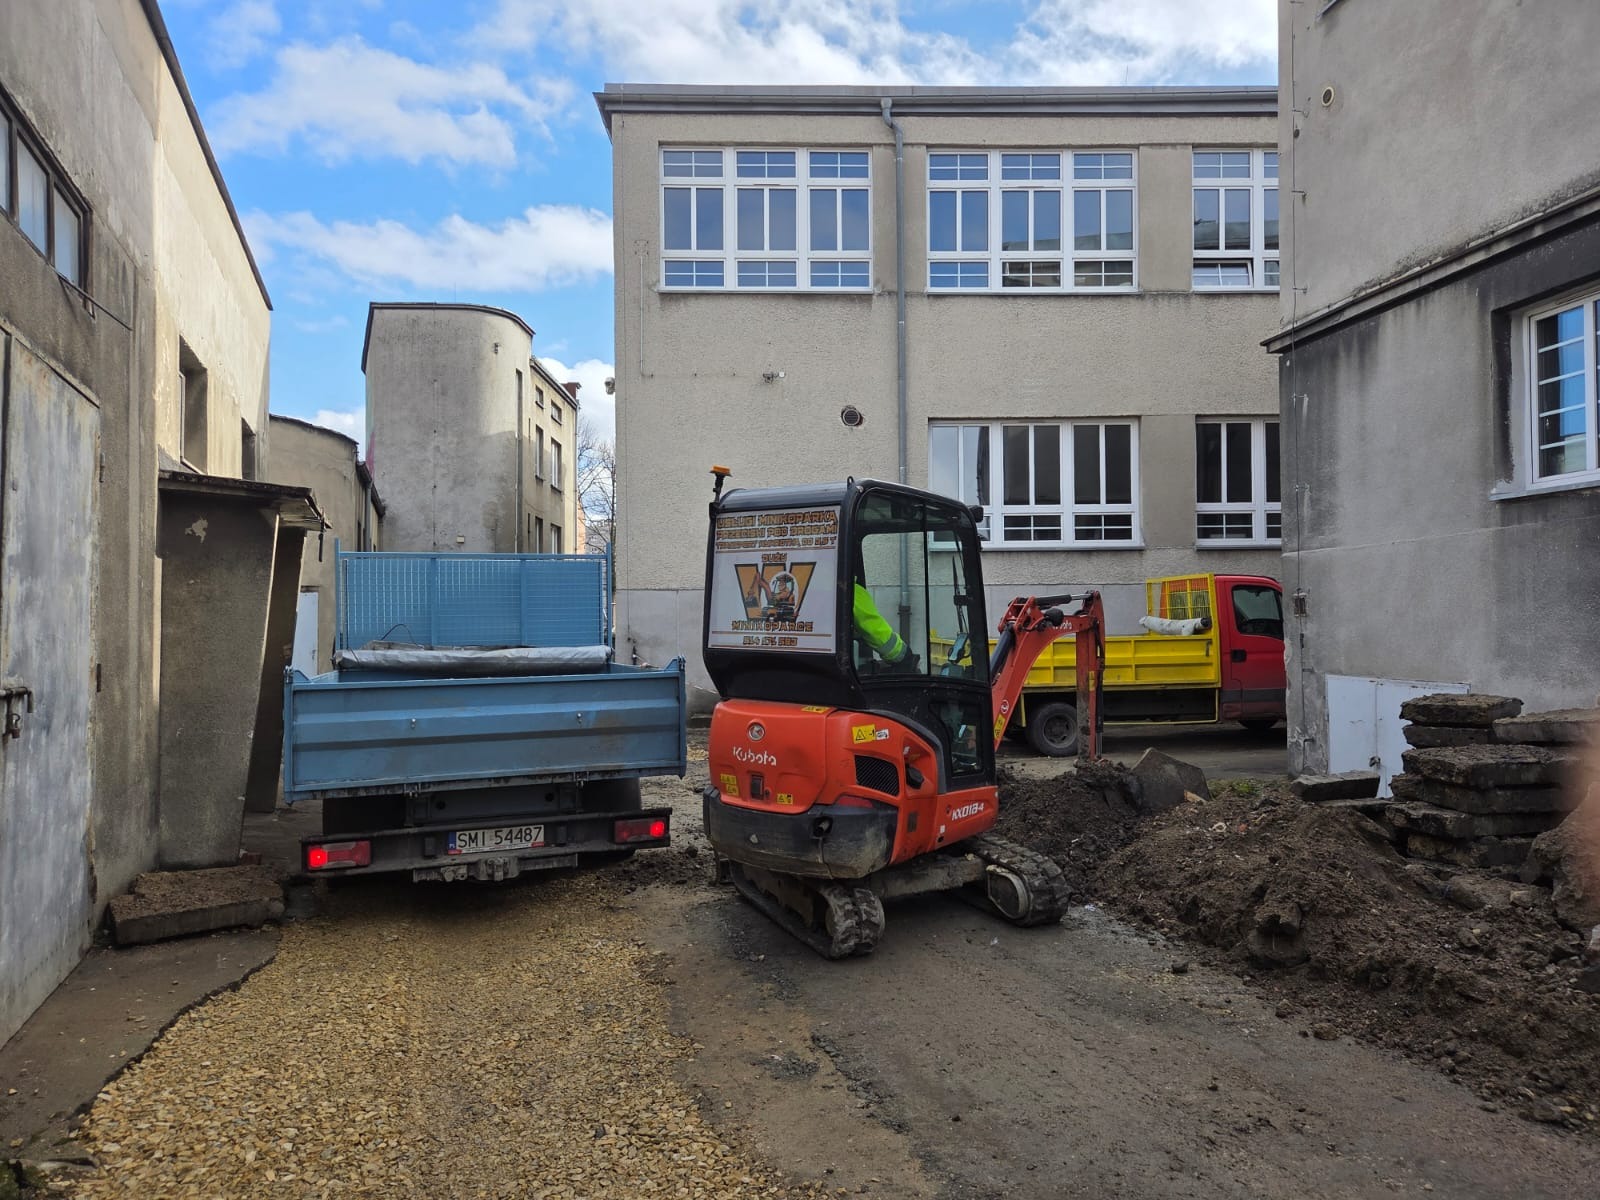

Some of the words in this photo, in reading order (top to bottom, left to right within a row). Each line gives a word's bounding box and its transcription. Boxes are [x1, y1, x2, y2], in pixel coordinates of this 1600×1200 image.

[717, 515, 756, 528] USŁUGI
[766, 526, 788, 537] POD
[789, 524, 837, 536] DROGAMI
[731, 620, 813, 632] MINIKOPARCE
[733, 746, 777, 766] Kubota
[951, 802, 985, 821] KX018-4
[457, 832, 486, 849] SMI
[494, 826, 543, 845] 54487
